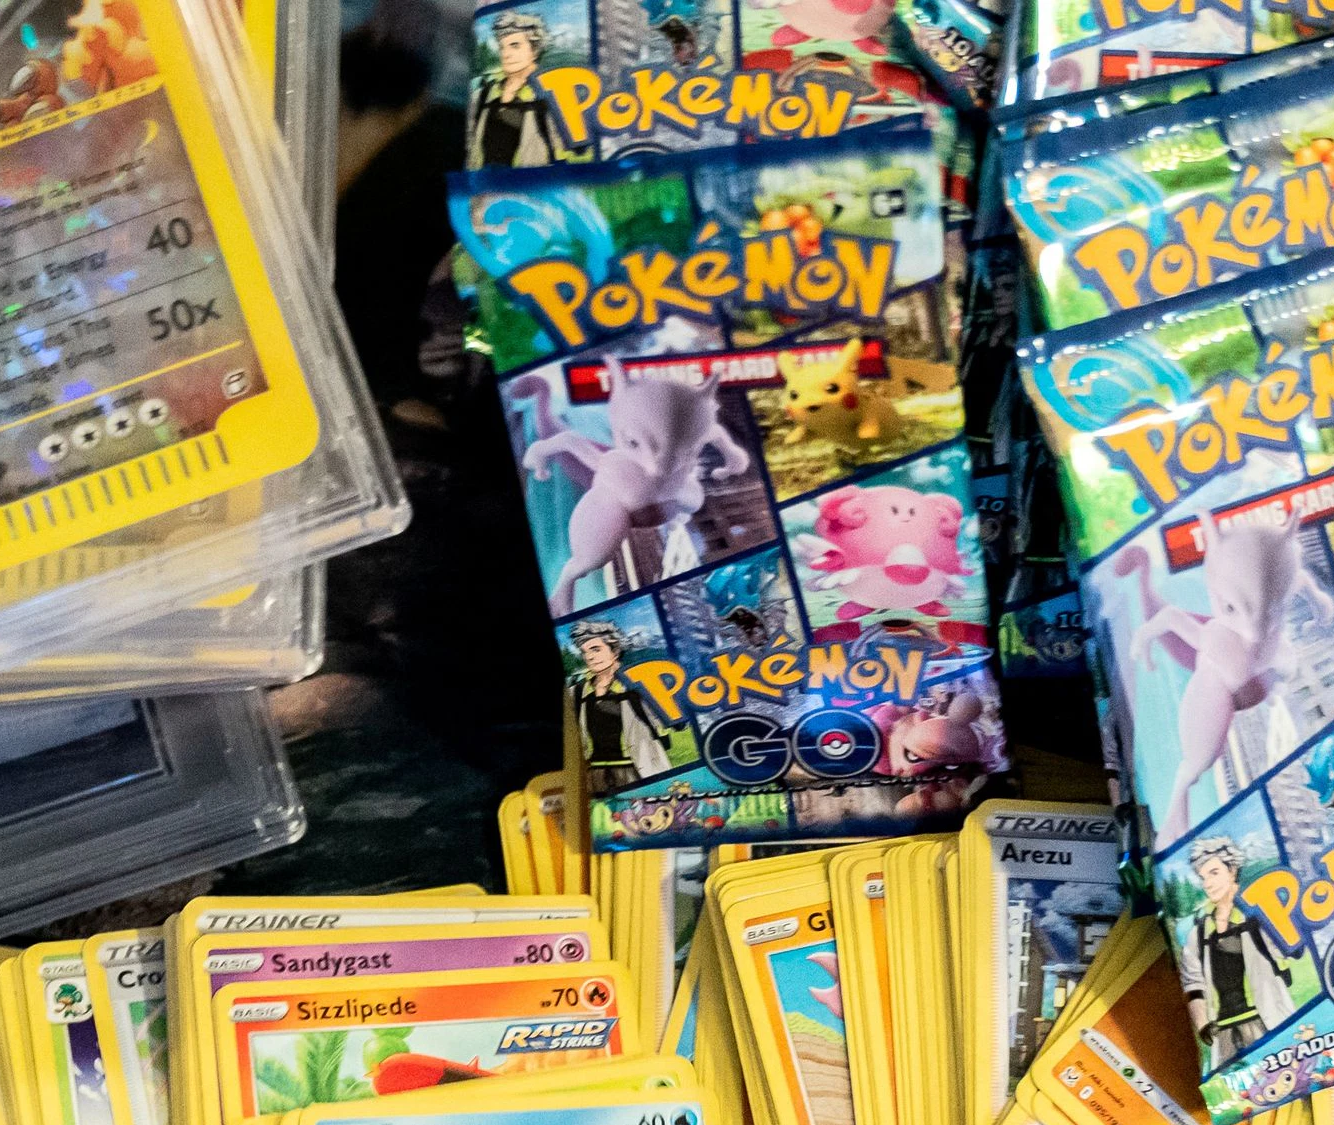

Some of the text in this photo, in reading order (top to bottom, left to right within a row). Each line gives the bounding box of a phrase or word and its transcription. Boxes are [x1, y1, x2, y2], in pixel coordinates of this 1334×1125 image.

[147, 216, 193, 255] 40
[147, 295, 222, 342] 50x
[596, 363, 705, 393] TADING
[1191, 501, 1287, 552] TADING
[703, 707, 883, 787] GO
[999, 842, 1072, 868] Arezu
[204, 912, 341, 931] TRAINER
[746, 920, 794, 942] BASIC
[105, 938, 164, 962] TRA
[207, 957, 257, 971] BASIC
[270, 948, 393, 976] Sandygast
[525, 944, 554, 965] 80
[116, 968, 166, 990] Cro
[233, 1005, 284, 1021] BASIC
[296, 994, 419, 1026] Sizzlipede
[551, 987, 580, 1009] 70
[502, 1020, 608, 1052] RAPID
[549, 1033, 606, 1051] STRIKE
